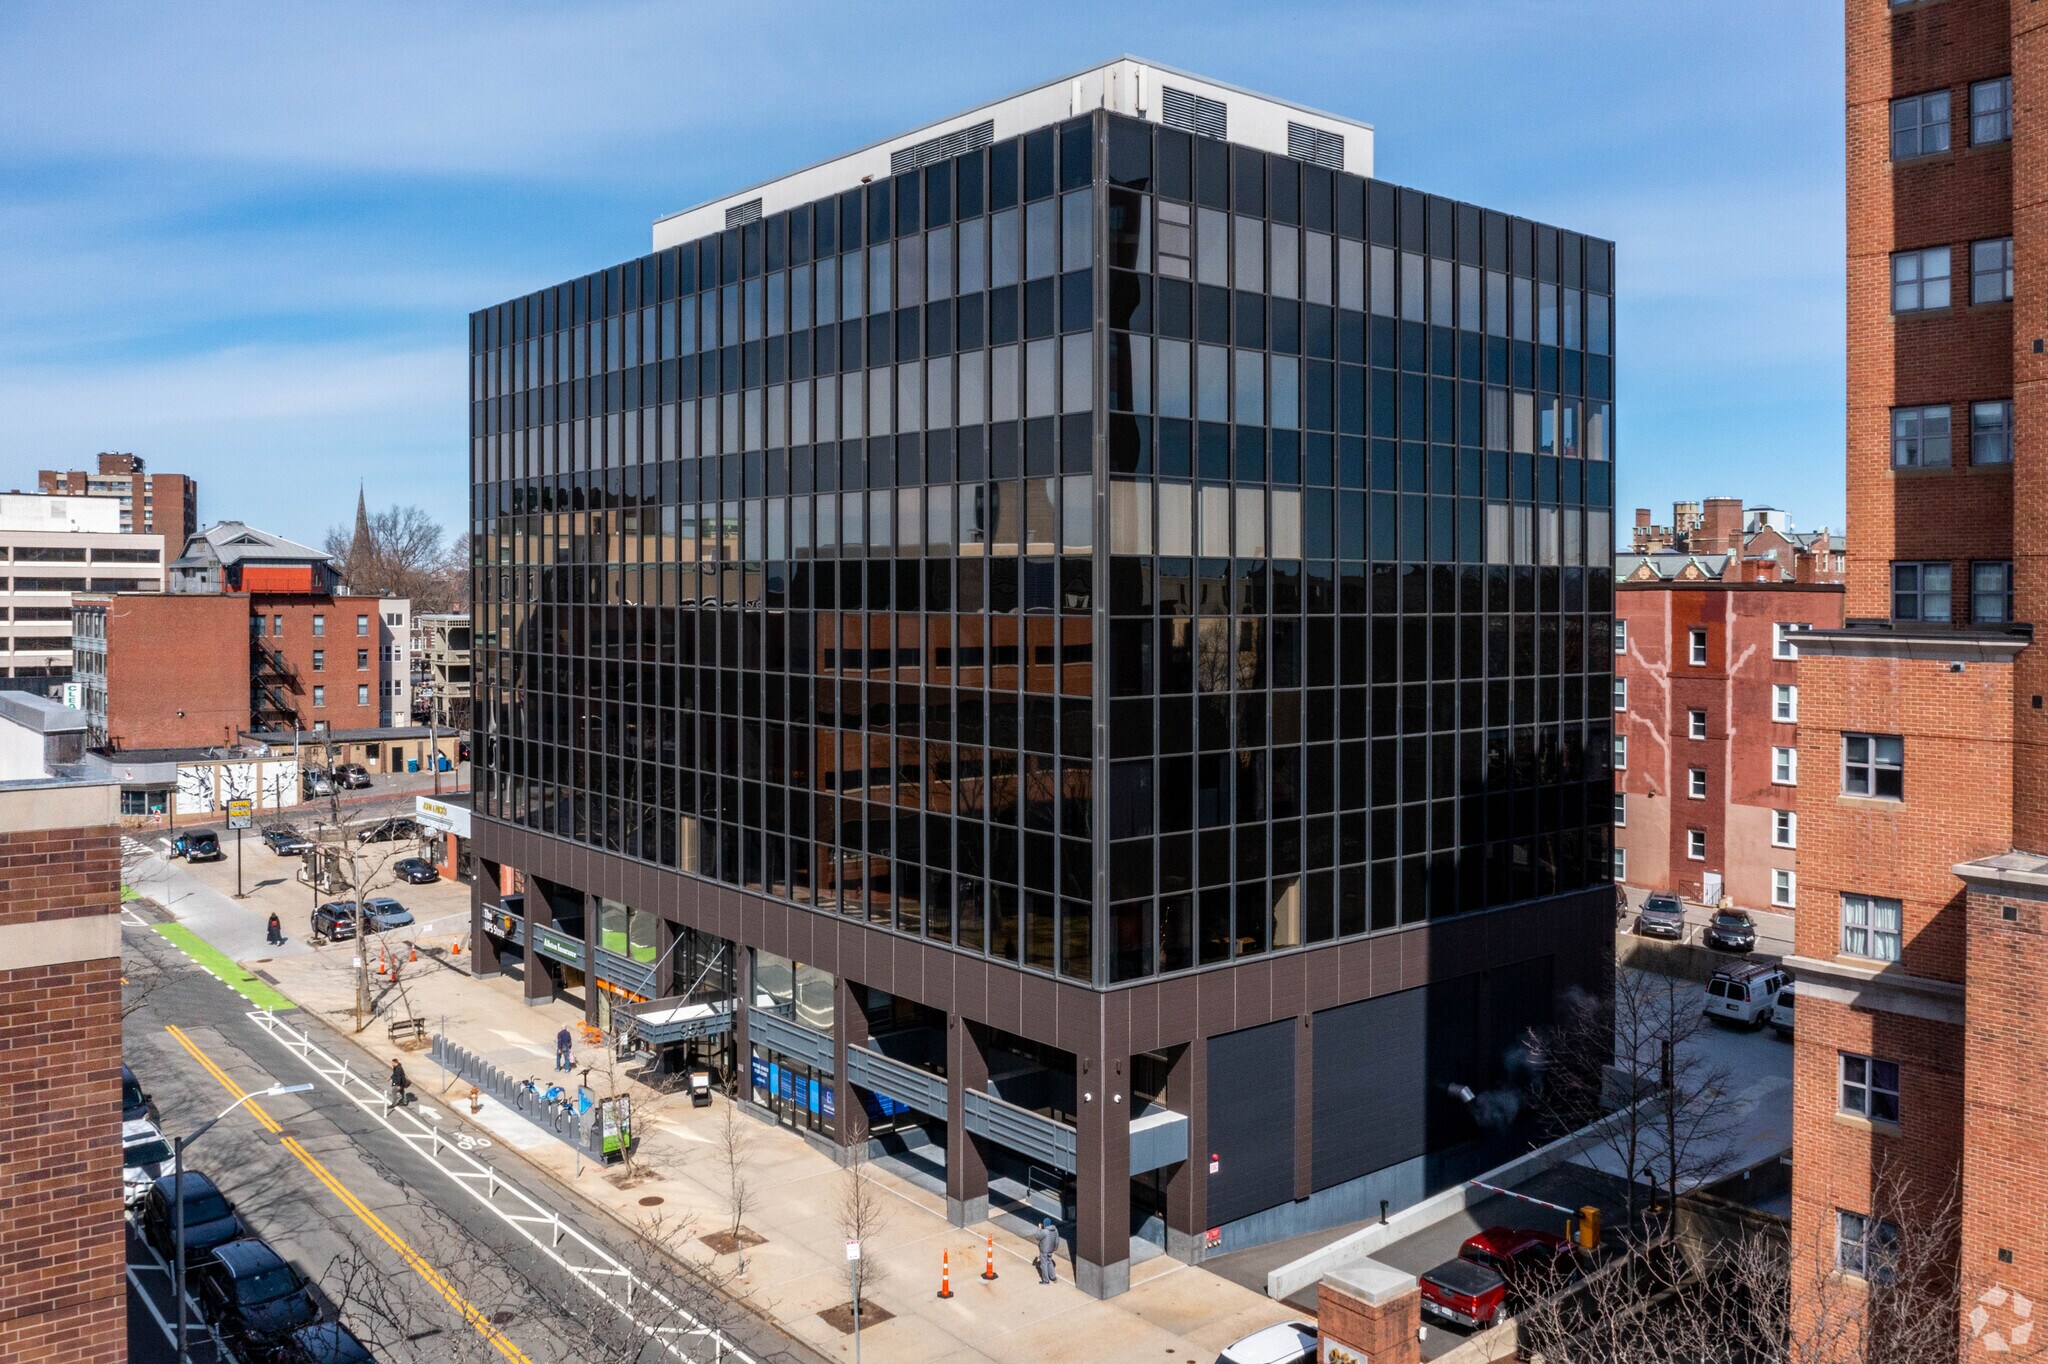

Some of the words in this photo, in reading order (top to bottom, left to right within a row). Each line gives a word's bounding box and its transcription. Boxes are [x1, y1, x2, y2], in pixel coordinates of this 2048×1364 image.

[483, 908, 493, 920] The
[484, 920, 494, 933] UPS
[494, 924, 505, 938] Store
[557, 943, 577, 959] Insurance
[680, 1021, 707, 1038] 955
